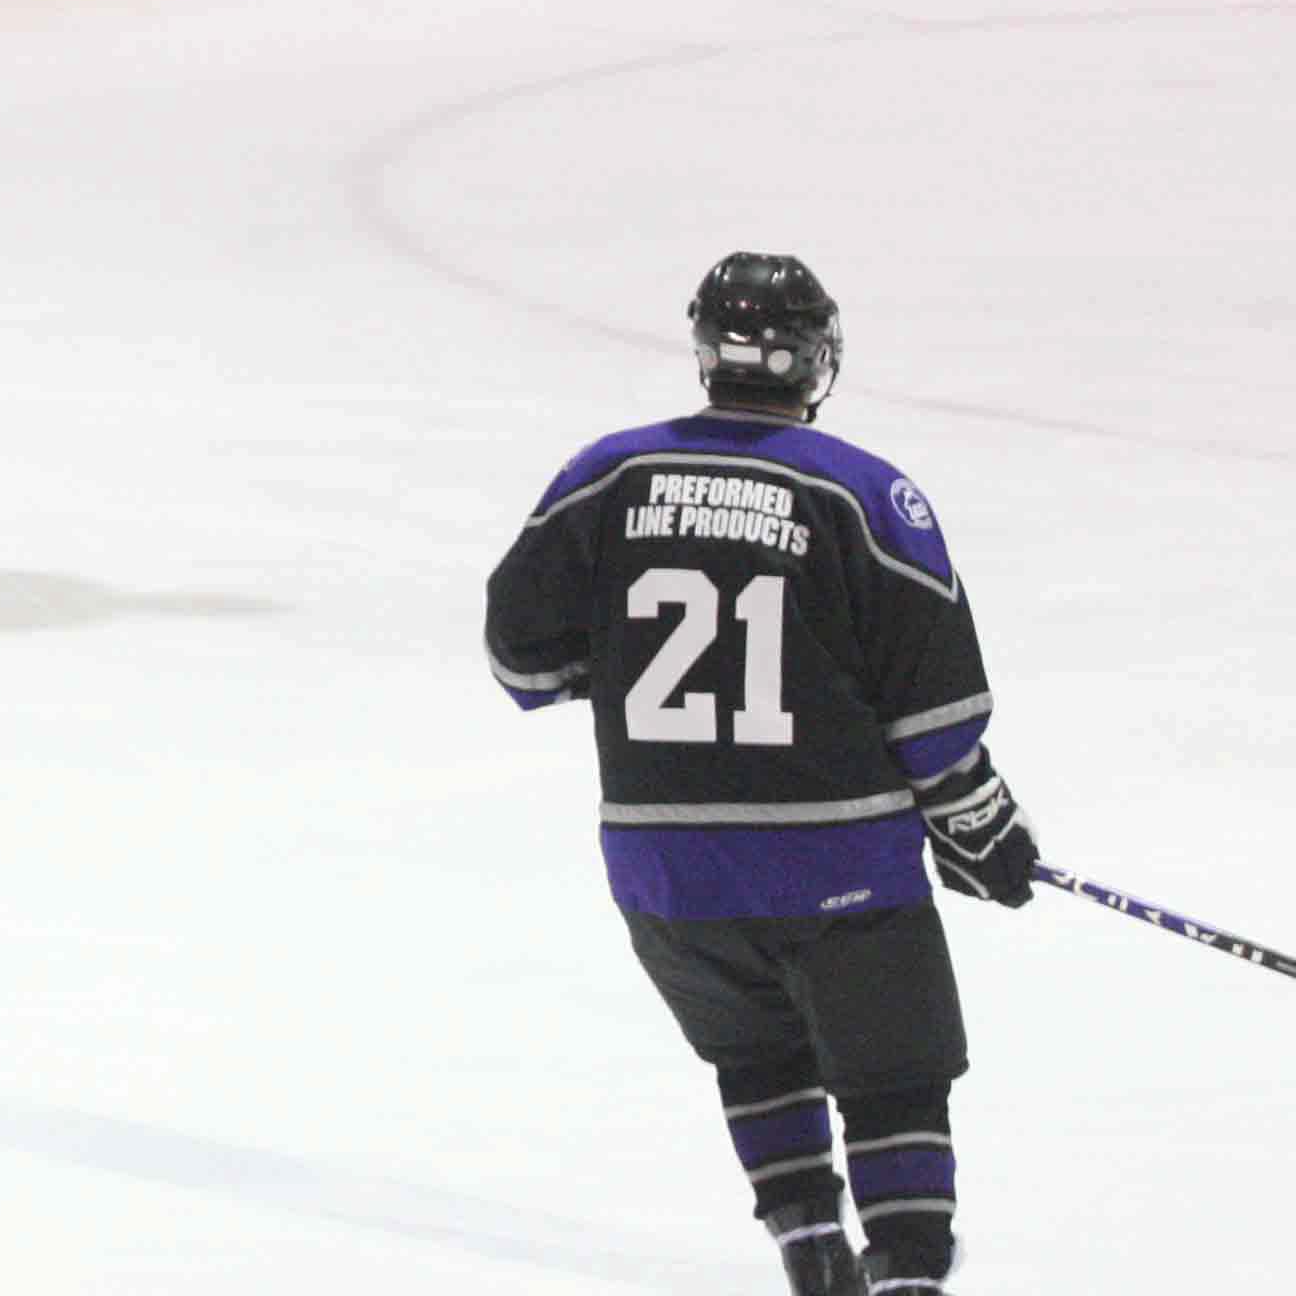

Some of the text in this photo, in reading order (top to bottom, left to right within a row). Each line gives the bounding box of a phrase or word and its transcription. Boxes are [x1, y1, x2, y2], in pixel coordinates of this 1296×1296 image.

[649, 473, 794, 519] PREFORMED
[625, 506, 811, 557] LINE PRODUCTS
[625, 568, 794, 747] 21
